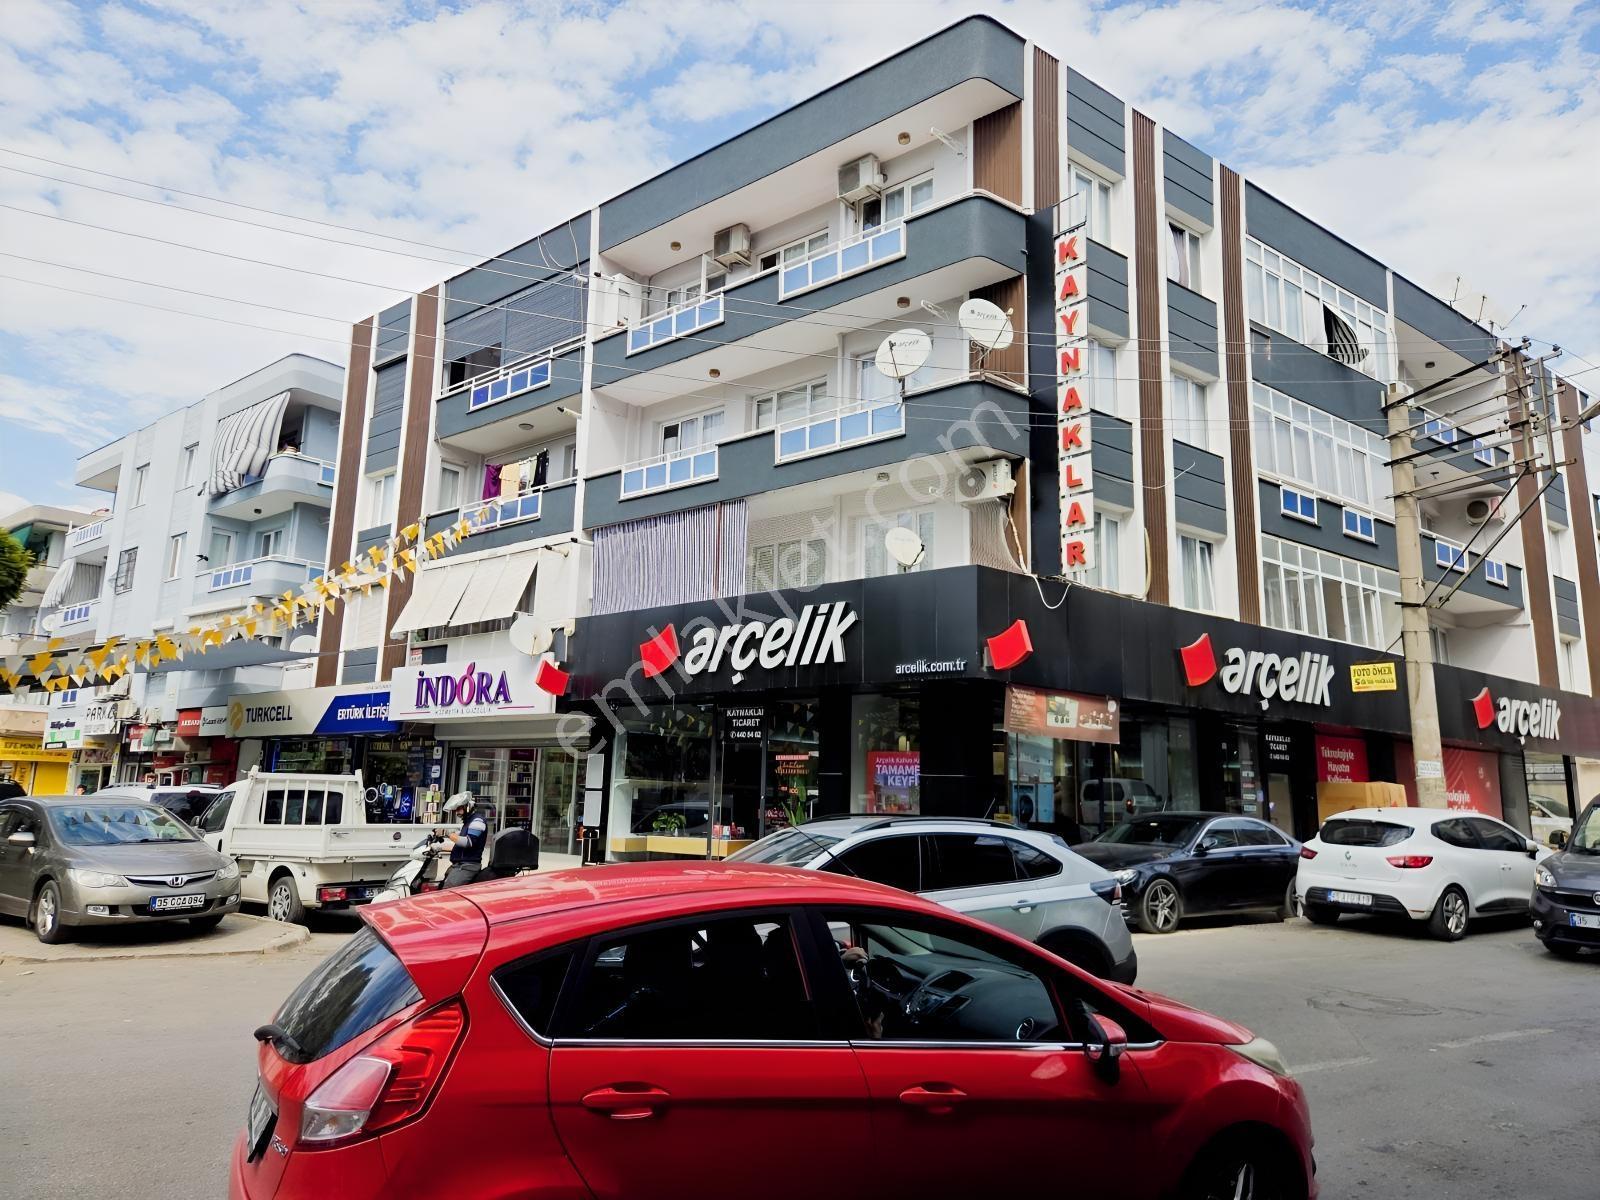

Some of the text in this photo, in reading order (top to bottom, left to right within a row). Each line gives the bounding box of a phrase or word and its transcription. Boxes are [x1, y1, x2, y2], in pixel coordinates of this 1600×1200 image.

[1057, 233, 1088, 571] KAYNAKLAR
[684, 600, 860, 686] arçelik
[895, 657, 967, 675] arcelik.com.tr
[1218, 646, 1335, 711] arçelik
[244, 704, 293, 724] TURKCELL
[337, 704, 365, 721] ERTÜRK
[1498, 696, 1561, 745] arçelik
